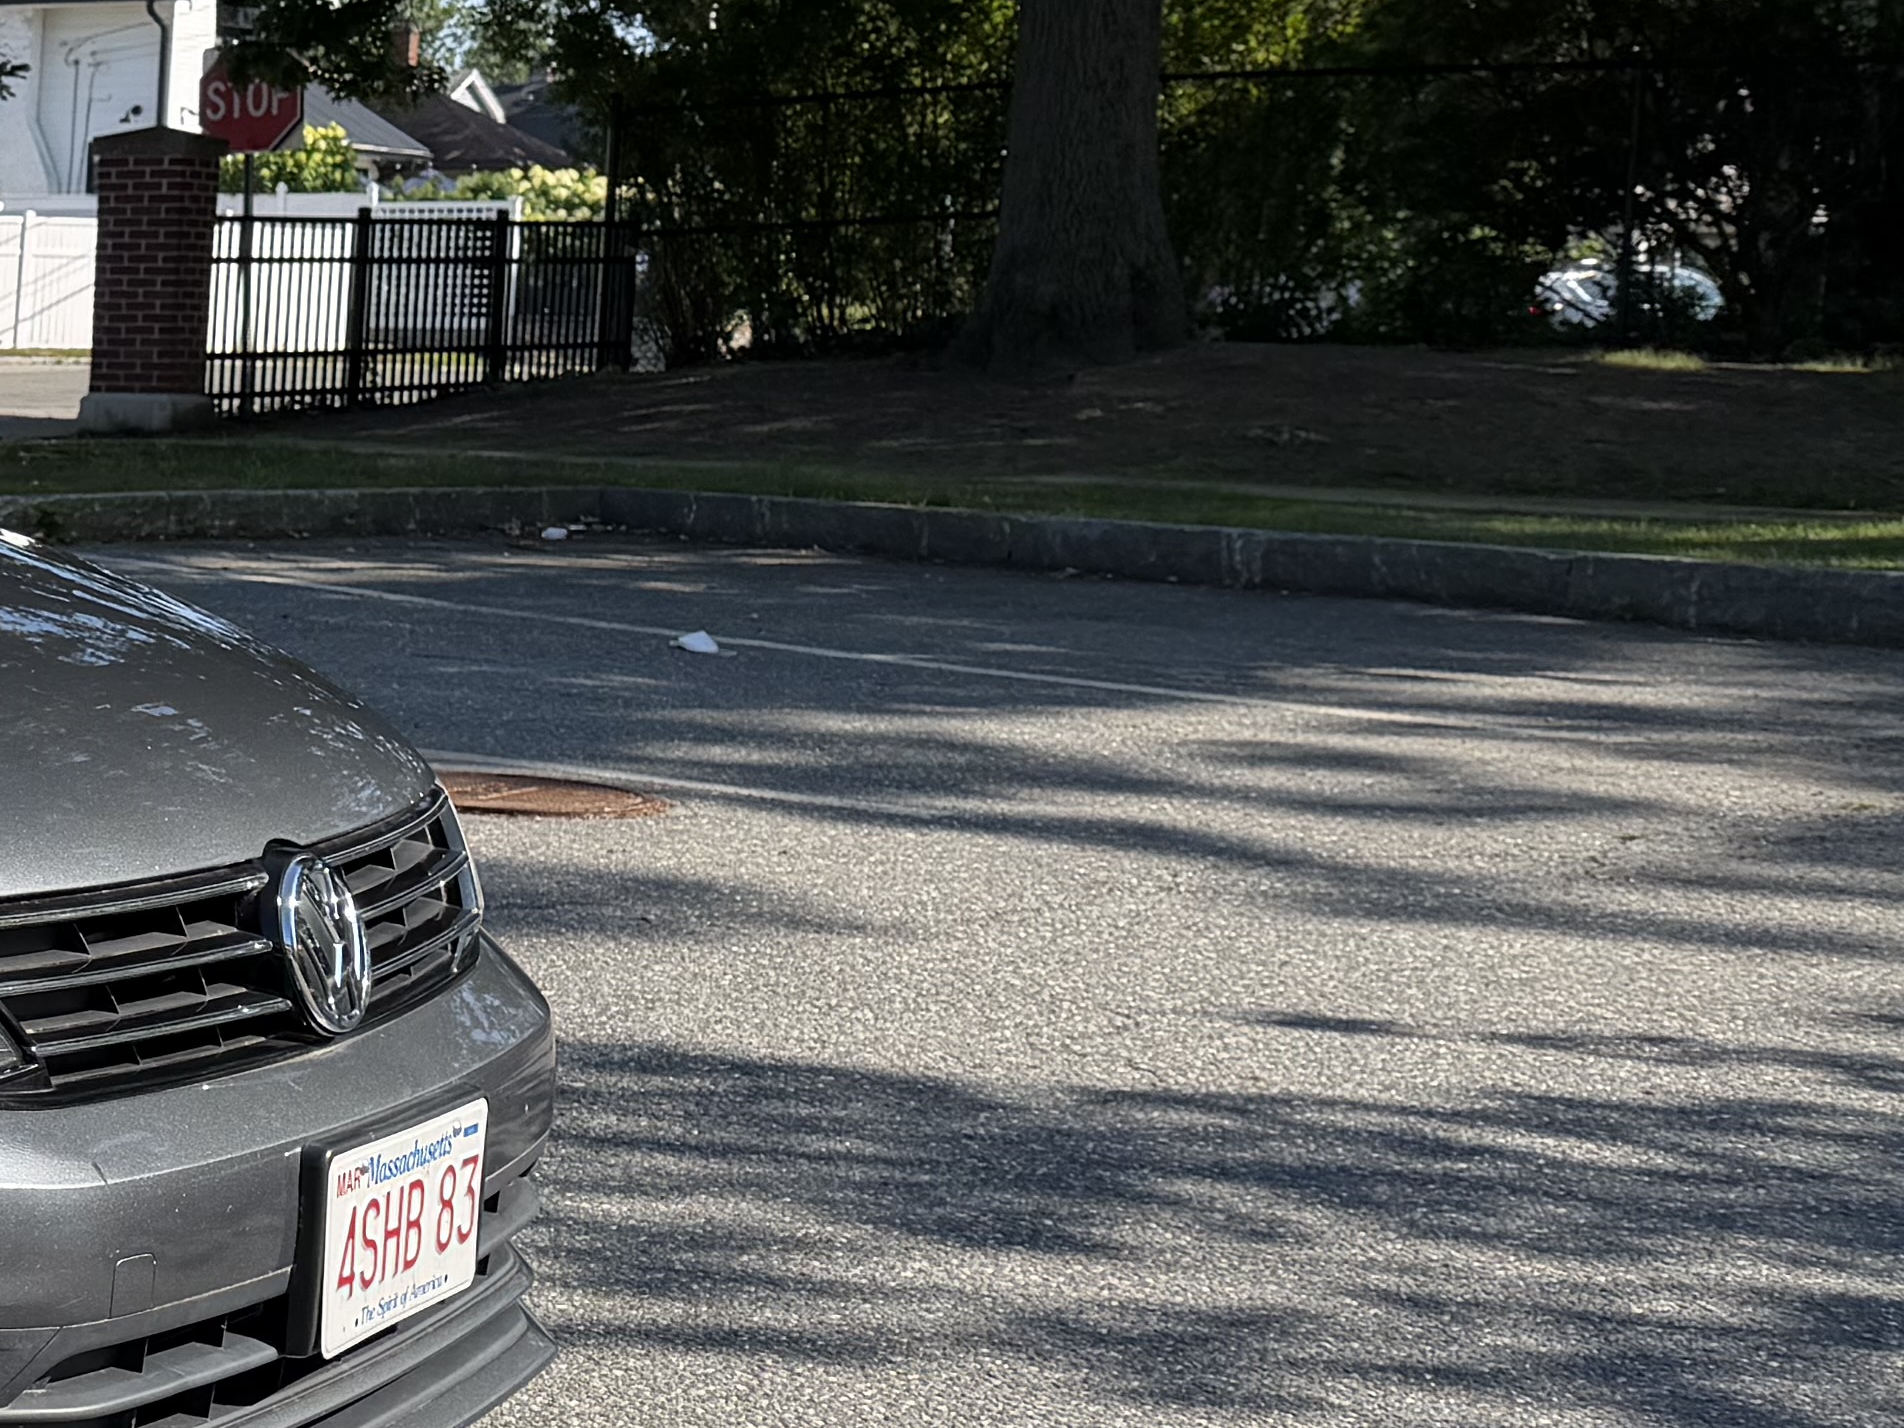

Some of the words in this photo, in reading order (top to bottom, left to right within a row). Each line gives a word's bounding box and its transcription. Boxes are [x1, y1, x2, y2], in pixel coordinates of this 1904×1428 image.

[337, 1166, 362, 1198] MAR
[367, 1130, 454, 1188] Massachusetts
[336, 1178, 425, 1301] 4SHB
[435, 1154, 480, 1256] 83
[359, 1303, 376, 1327] The
[379, 1292, 399, 1319] Spirit
[400, 1288, 409, 1306] of
[410, 1278, 444, 1303] America
